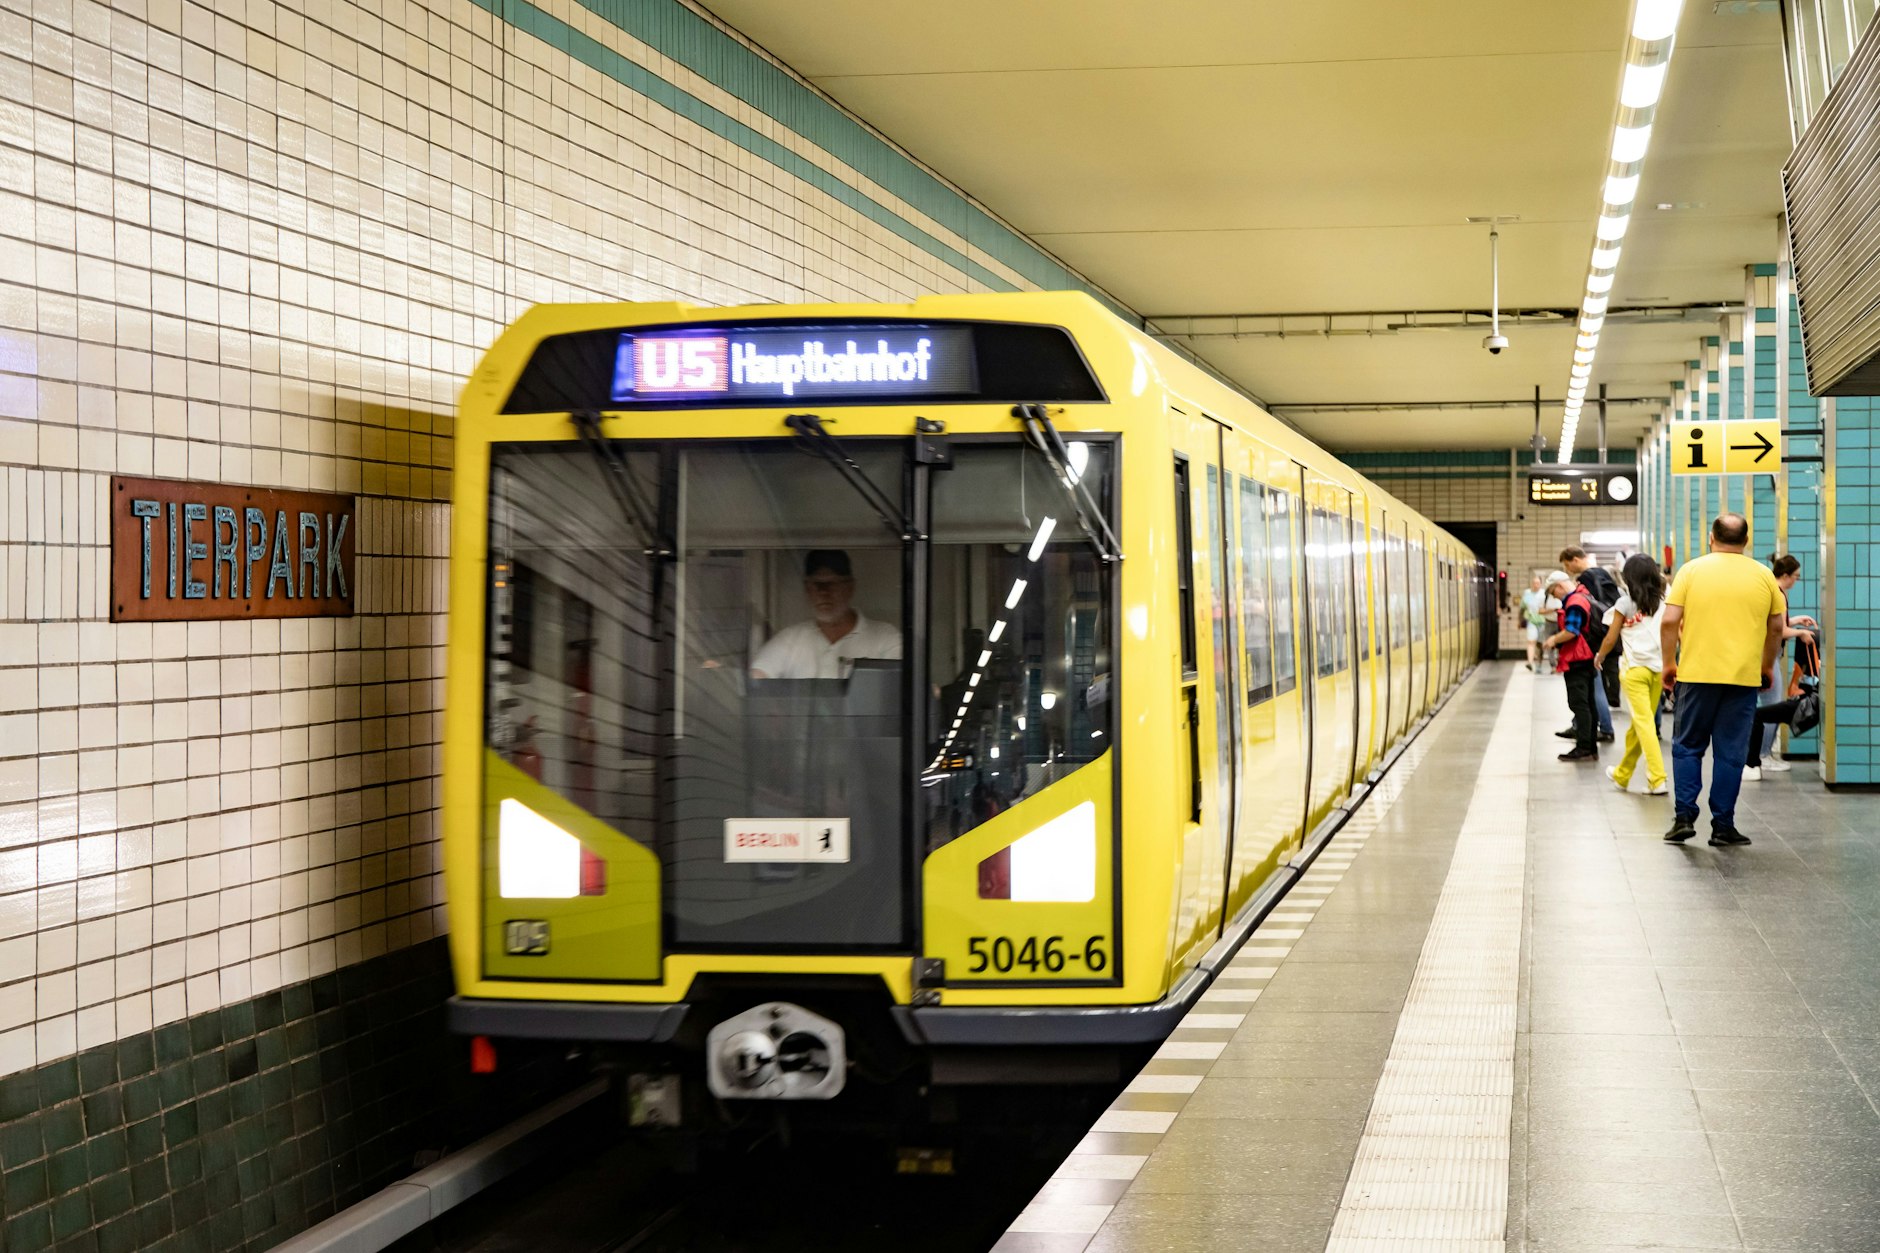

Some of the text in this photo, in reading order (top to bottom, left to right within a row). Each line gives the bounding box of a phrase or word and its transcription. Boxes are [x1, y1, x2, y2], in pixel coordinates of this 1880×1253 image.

[641, 338, 931, 396] U5 Hauptbahnhof
[132, 499, 349, 599] TIERPARK
[735, 832, 800, 848] BERLIN
[968, 935, 1107, 973] 5046-6
